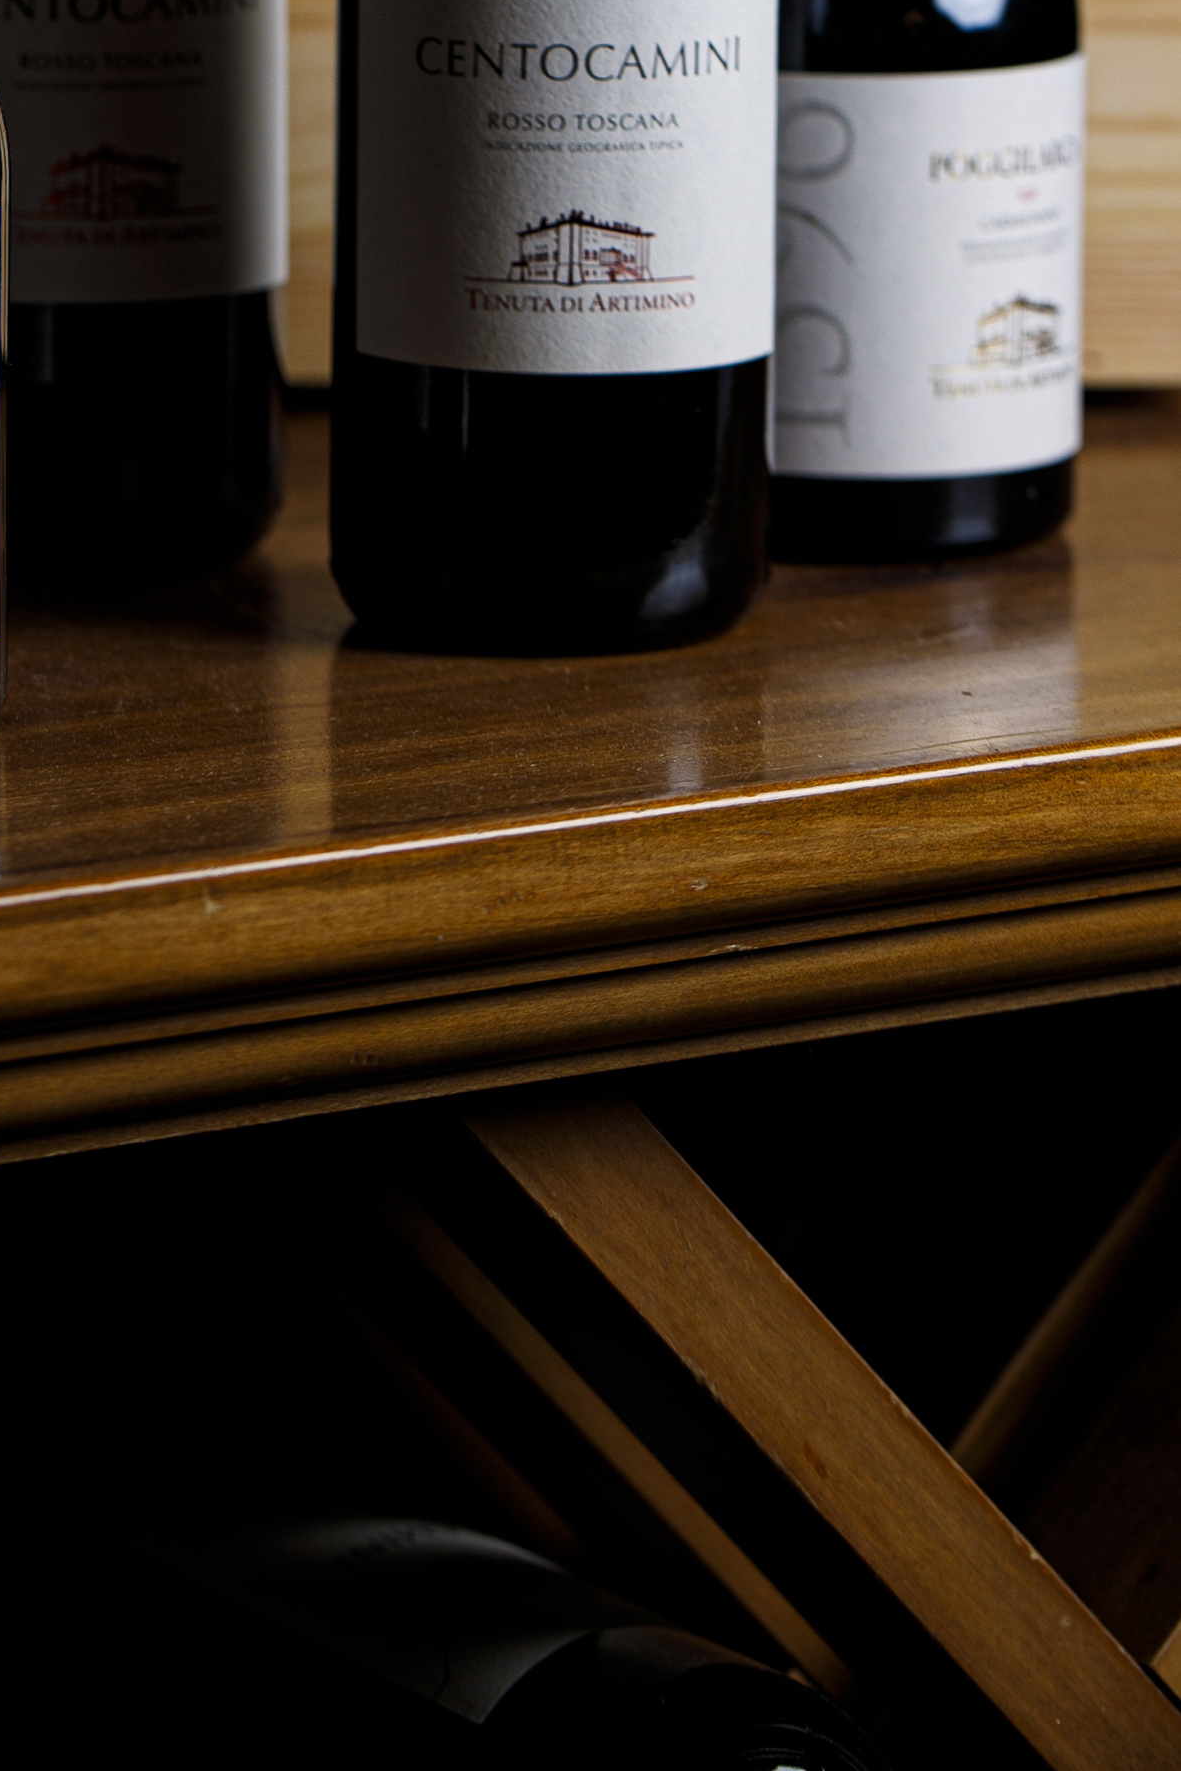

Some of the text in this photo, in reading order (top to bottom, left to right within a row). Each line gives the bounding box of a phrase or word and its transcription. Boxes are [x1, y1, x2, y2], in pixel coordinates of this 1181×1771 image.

[415, 35, 741, 82] CENTOCAMINI
[487, 111, 680, 132] ROSSO TOSCANA
[463, 288, 696, 314] TENUTA DI ARTIMINO
